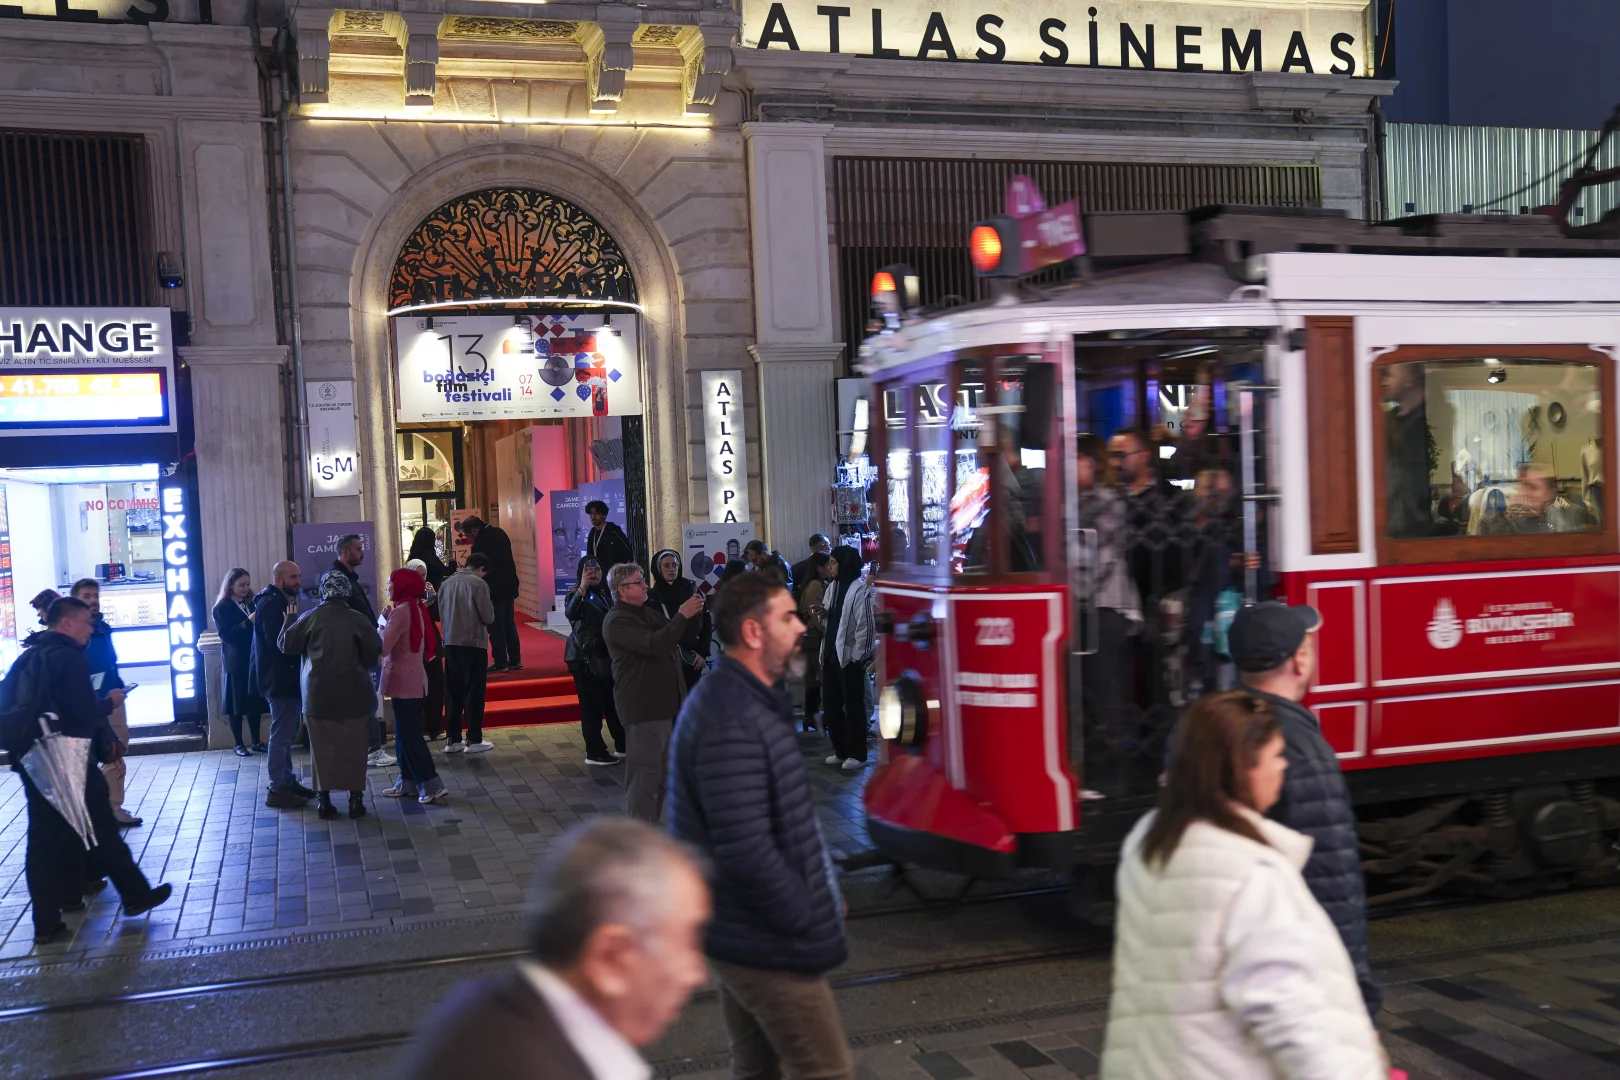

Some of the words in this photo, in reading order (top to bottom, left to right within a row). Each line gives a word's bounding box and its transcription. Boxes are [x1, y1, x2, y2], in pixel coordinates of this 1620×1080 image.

[756, 2, 1007, 62] ATLAS
[1039, 6, 1356, 77] SİNEMAS
[437, 334, 488, 380] 13
[444, 387, 512, 403] festivali
[518, 374, 533, 385] 07
[519, 386, 533, 396] 14
[716, 381, 734, 475] ATLAS
[85, 500, 104, 511] NO
[162, 487, 195, 699] EXCHANGE
